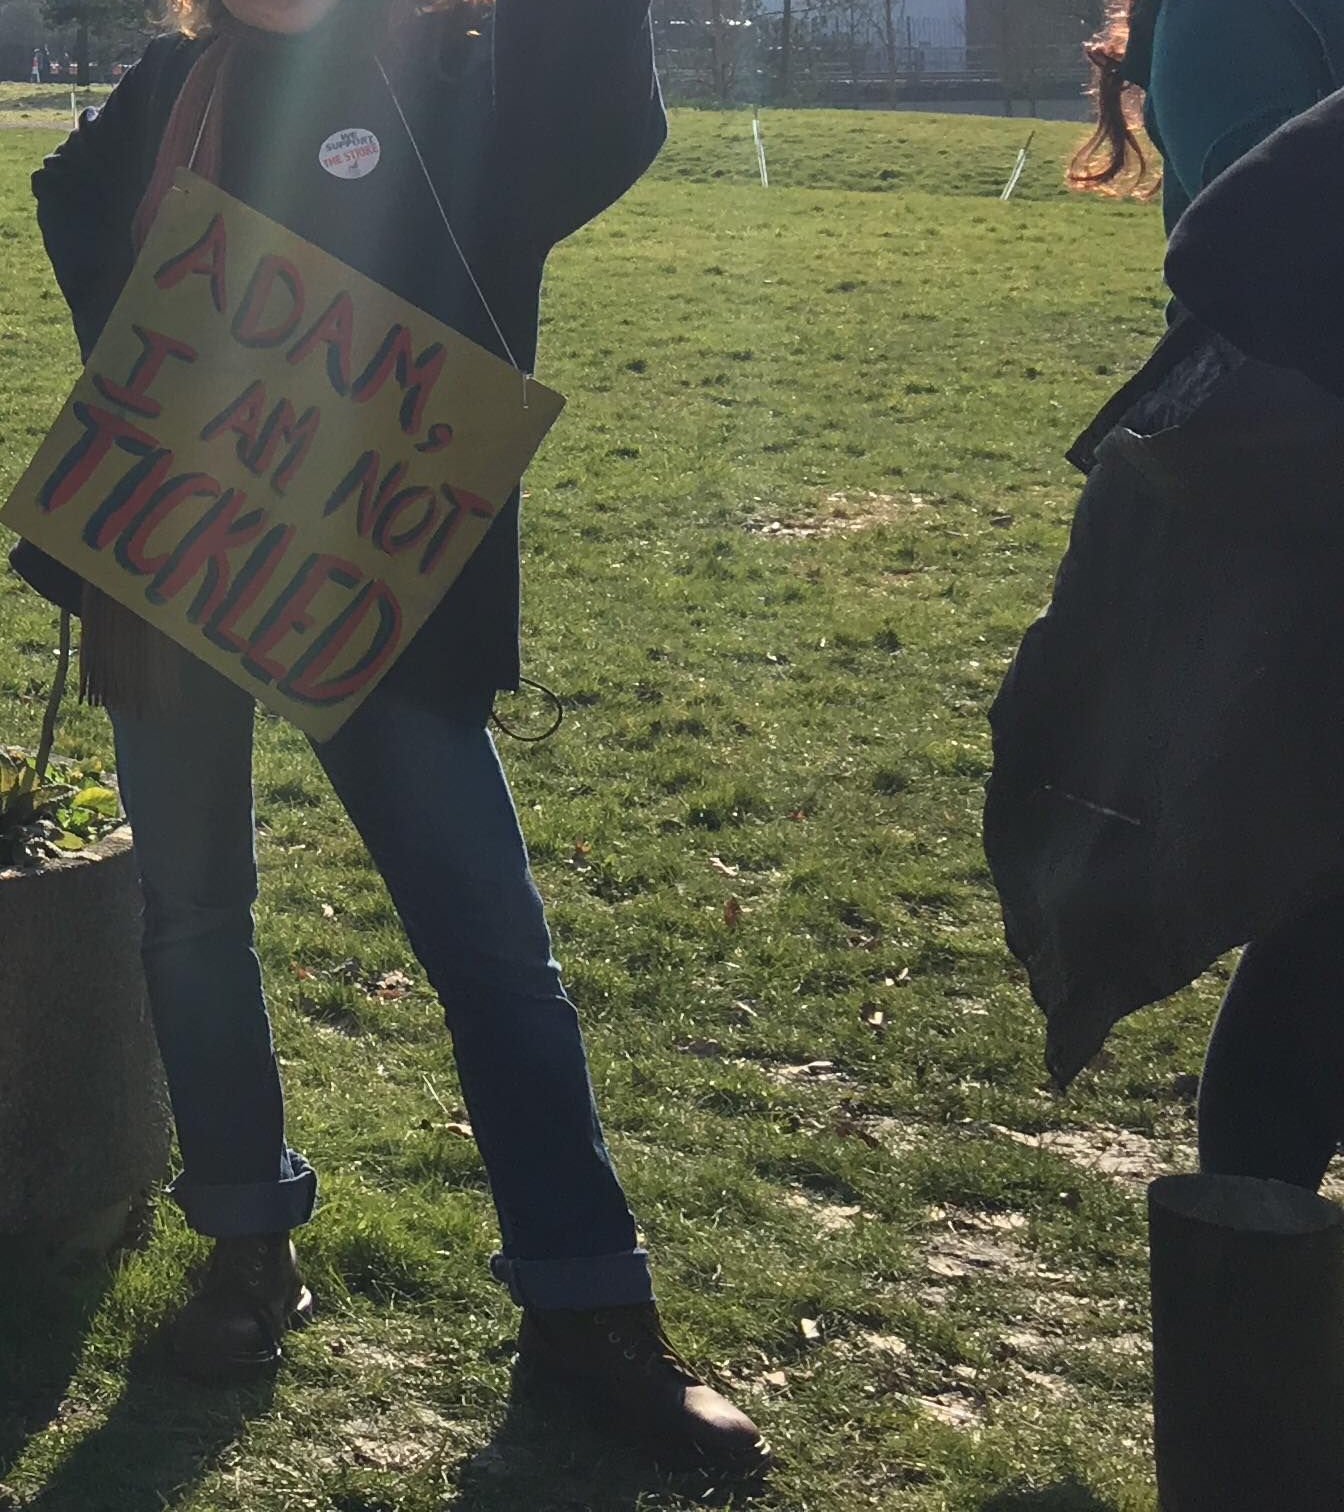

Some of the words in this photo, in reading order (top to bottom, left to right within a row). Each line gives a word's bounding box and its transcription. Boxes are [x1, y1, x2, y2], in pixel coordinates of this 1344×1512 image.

[322, 155, 343, 167] THE
[343, 143, 379, 162] STRIKE
[325, 135, 374, 152] SUPPORT
[92, 324, 199, 420] I
[200, 378, 322, 498] AM
[322, 448, 495, 575] NOT
[152, 213, 454, 454] ADAM,
[35, 400, 405, 706] TICKLED
